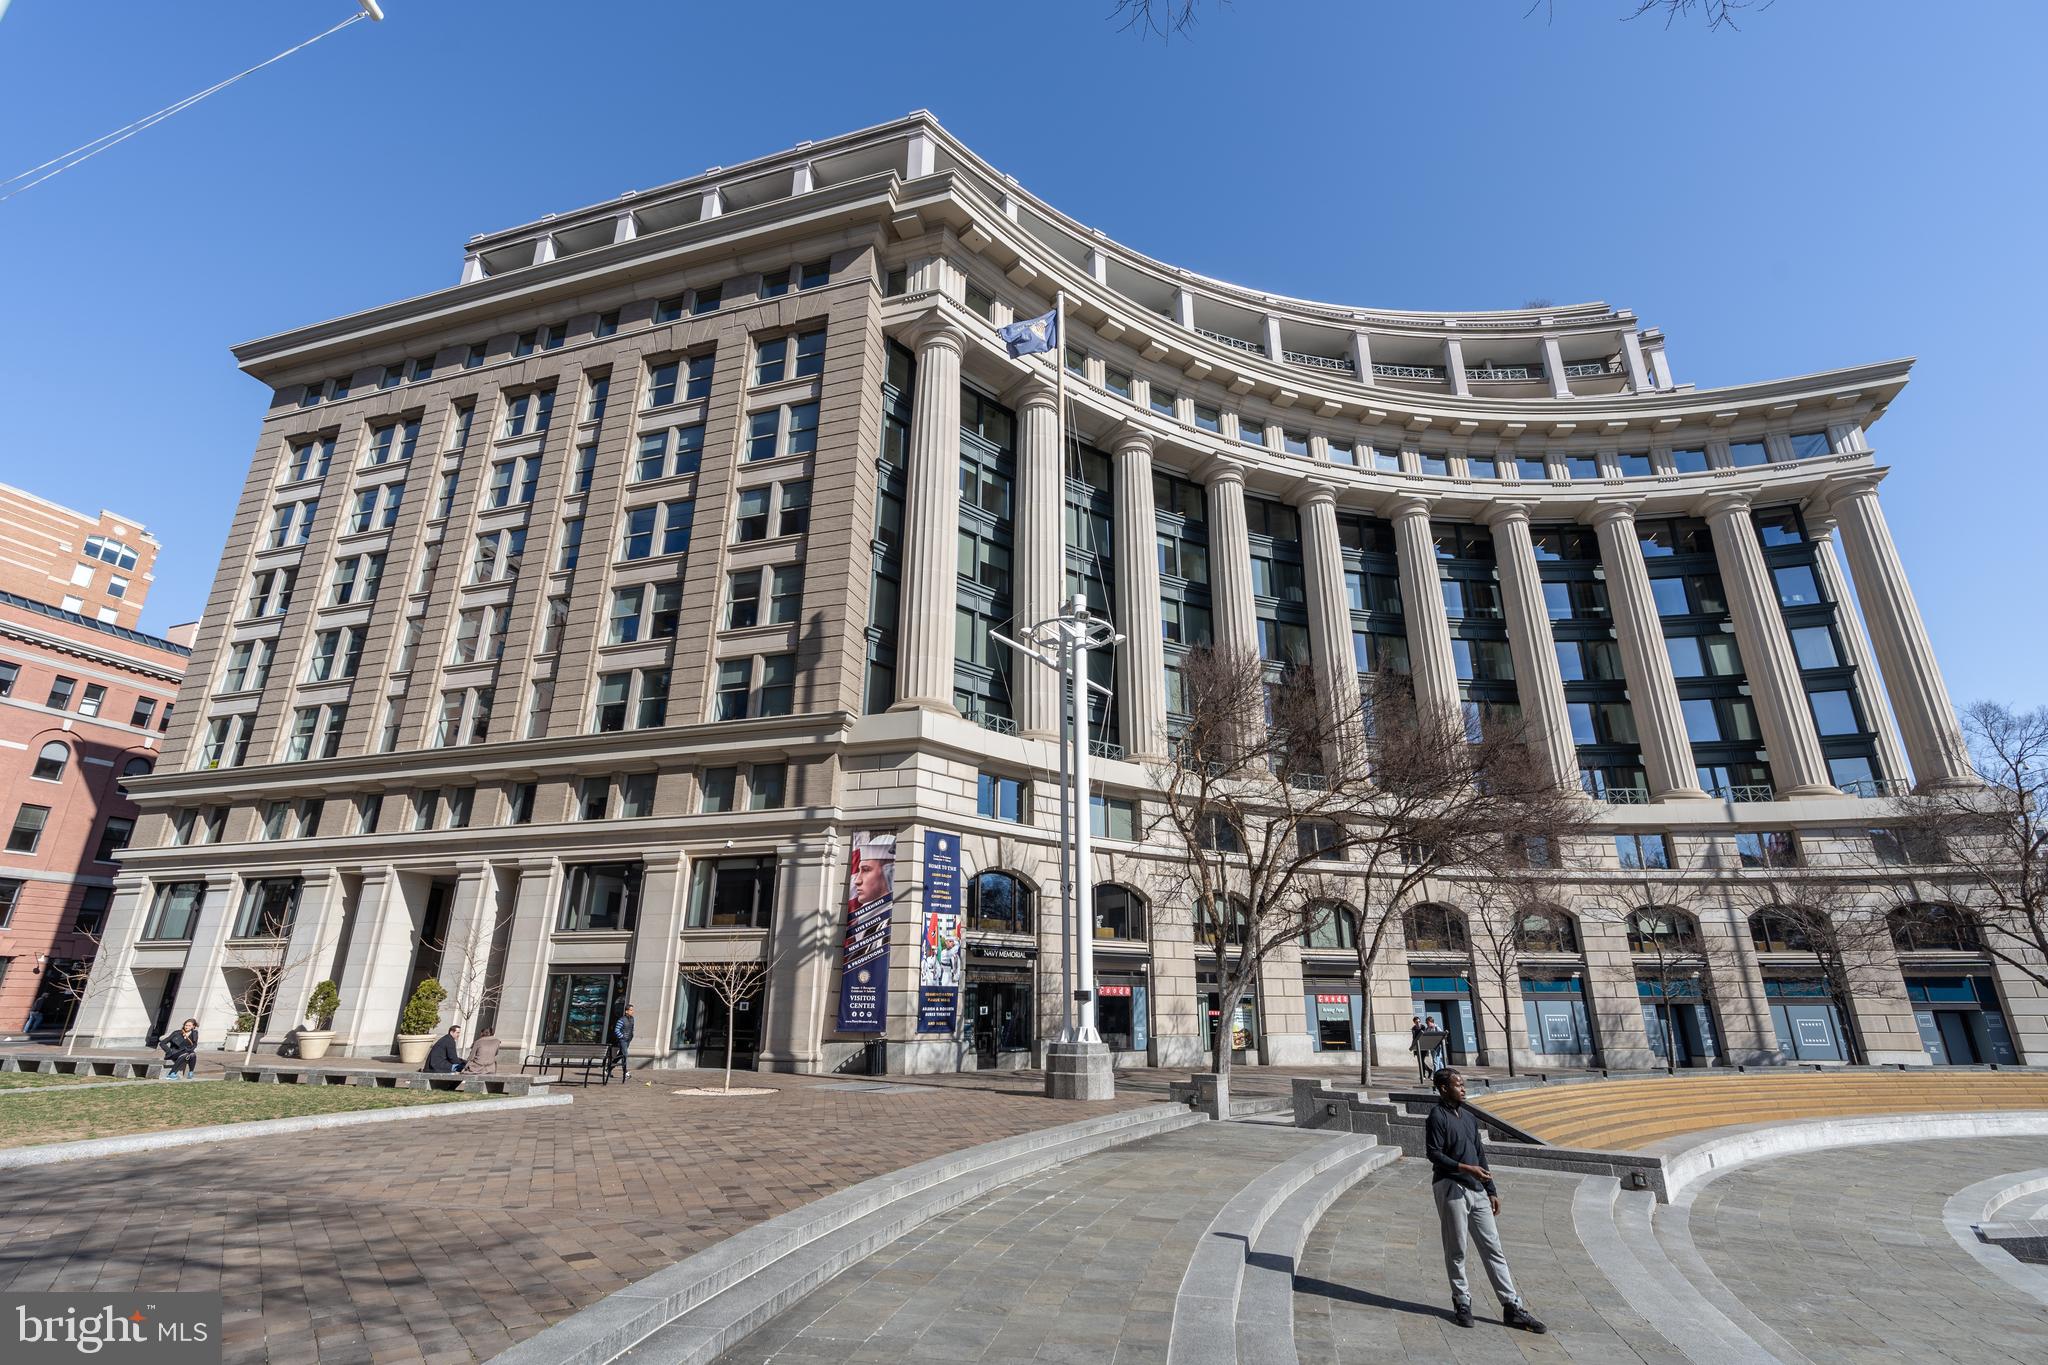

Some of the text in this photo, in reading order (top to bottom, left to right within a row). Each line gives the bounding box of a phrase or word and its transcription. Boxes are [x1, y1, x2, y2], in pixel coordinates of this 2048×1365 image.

[854, 898, 885, 917] FREE EXHIBITS
[855, 916, 882, 933] LIVE EVENTS
[848, 930, 886, 952] NEW PROGRAMS
[851, 947, 884, 967] PRODUCTIONS
[983, 949, 1027, 959] NAVY MEMORIAL
